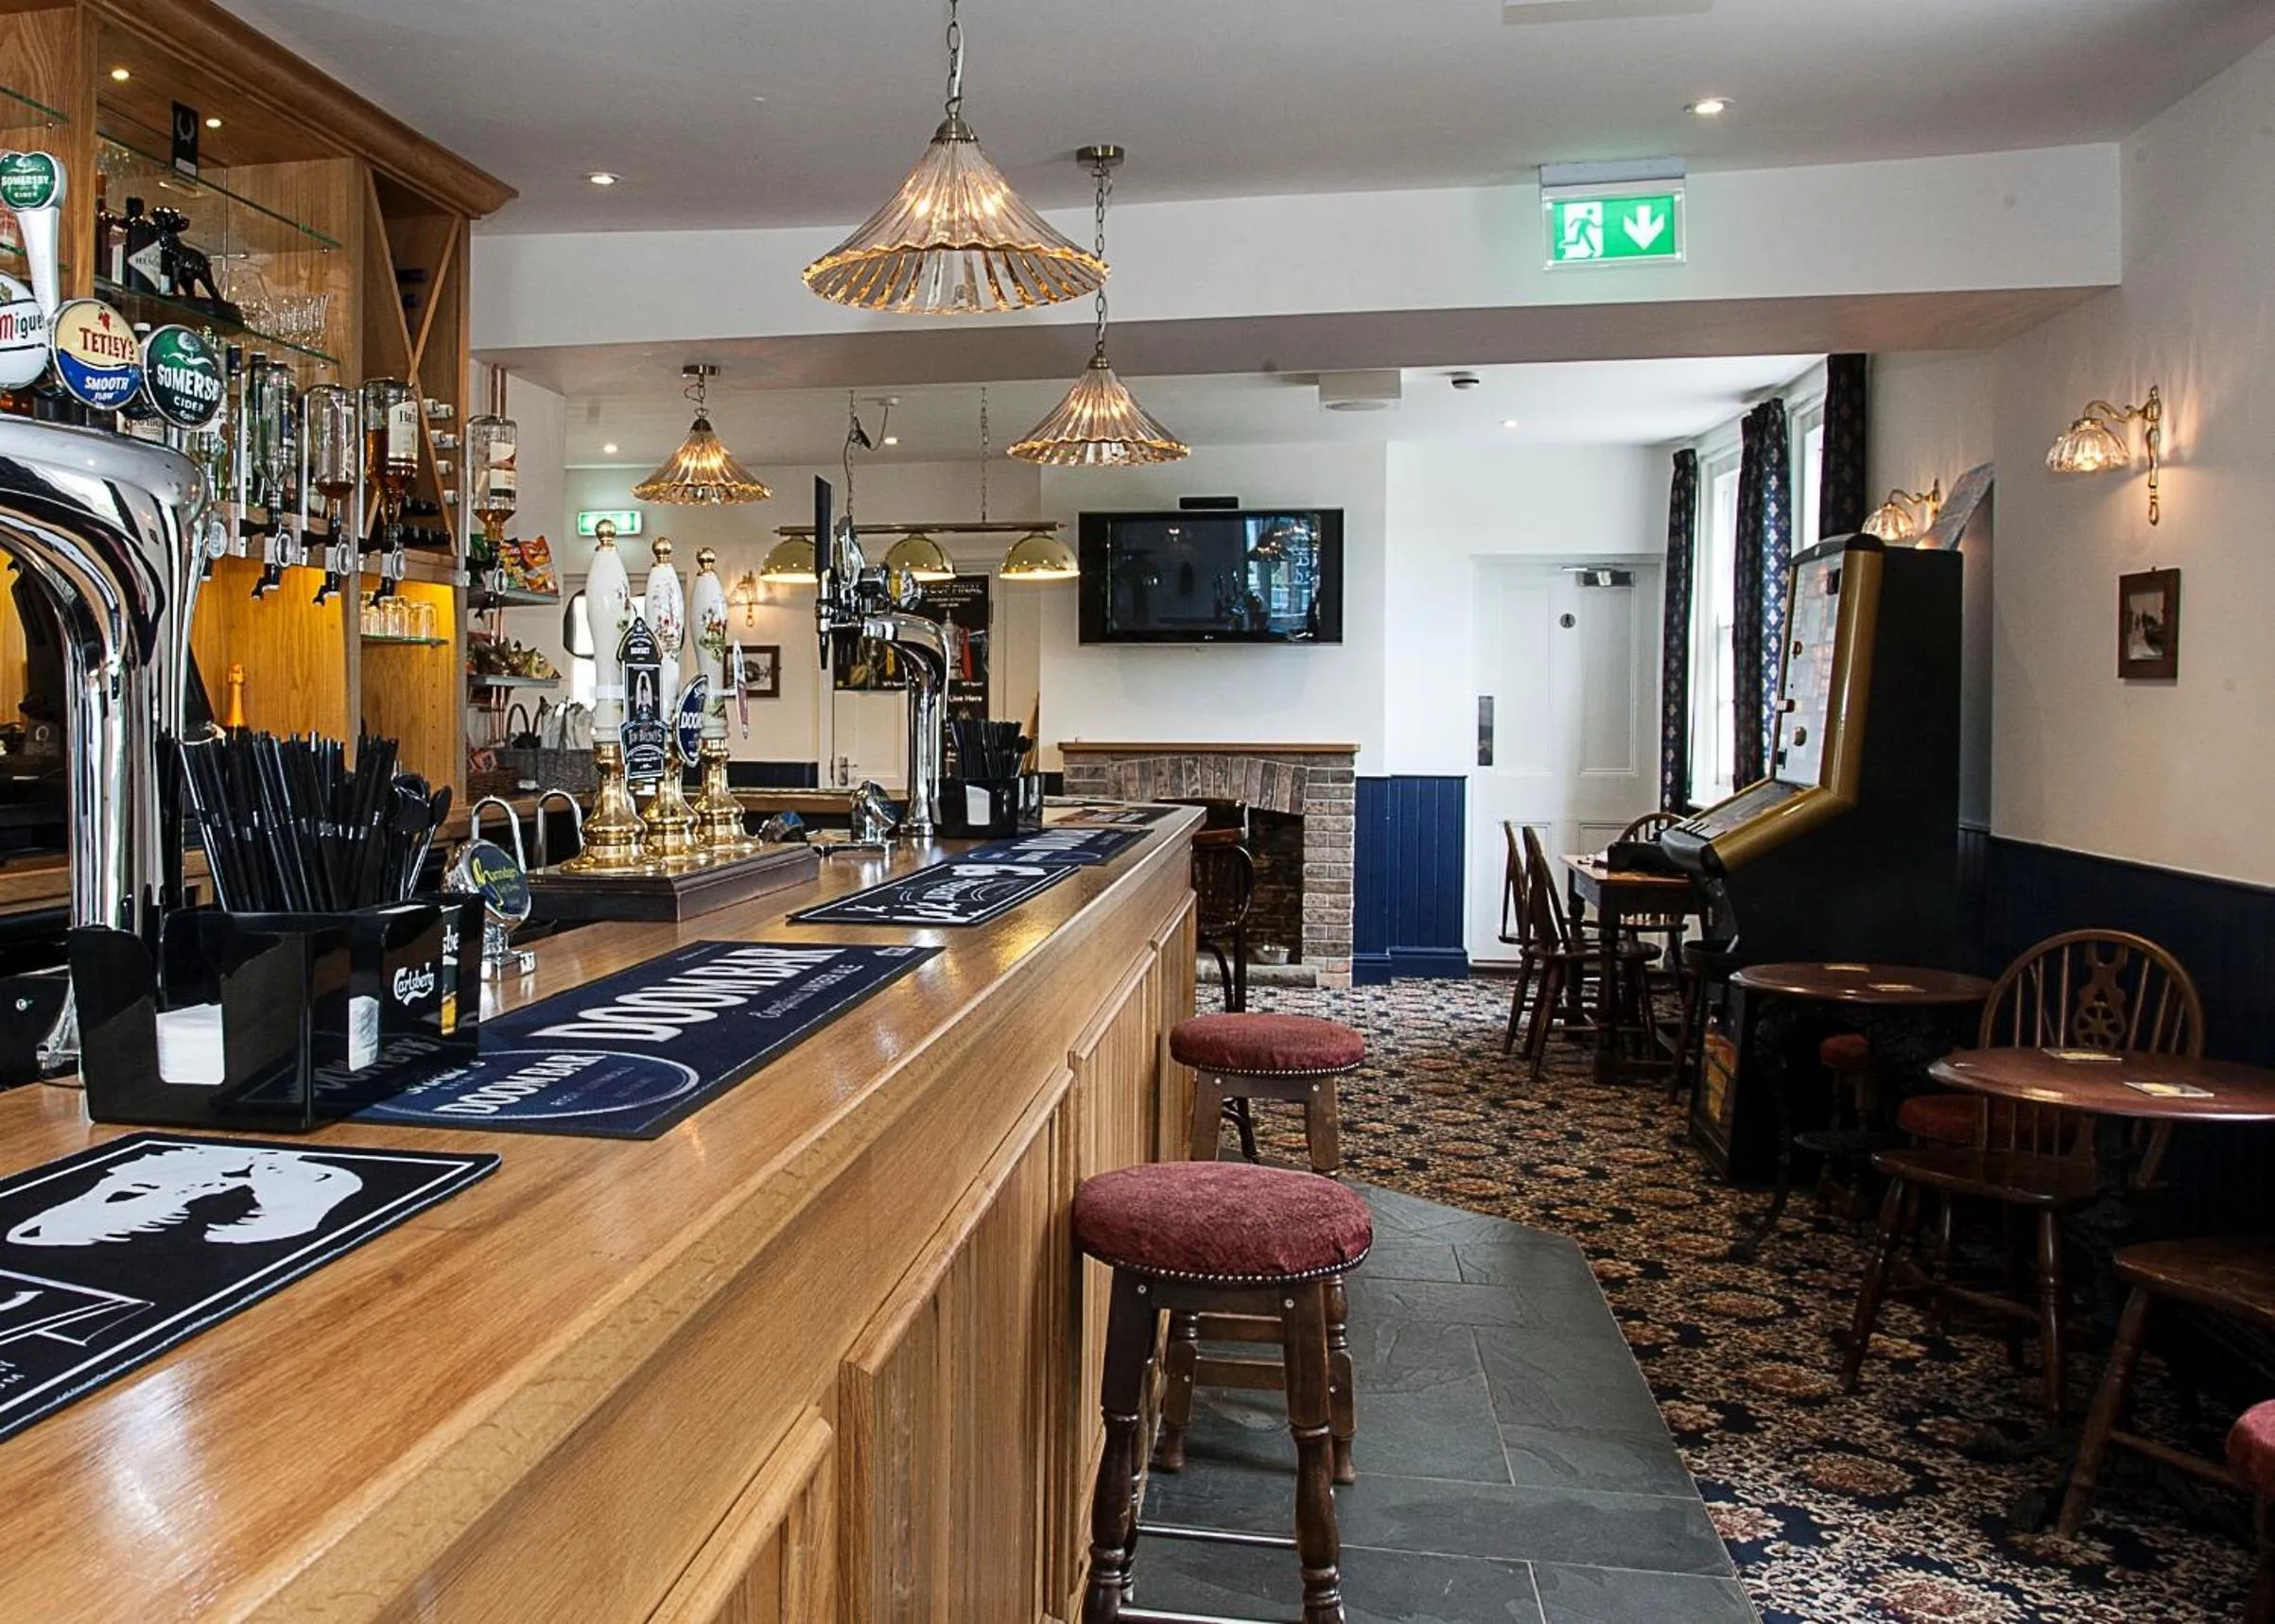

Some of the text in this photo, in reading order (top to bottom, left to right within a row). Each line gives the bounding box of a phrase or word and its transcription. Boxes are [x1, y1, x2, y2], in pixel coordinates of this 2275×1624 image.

[0, 311, 43, 339] Migue
[78, 326, 134, 361] TETLEY'S
[84, 375, 130, 390] SMOOTH
[157, 364, 219, 402] SOMERSB
[174, 396, 204, 412] CIDER
[393, 961, 435, 1006] Carlsberg
